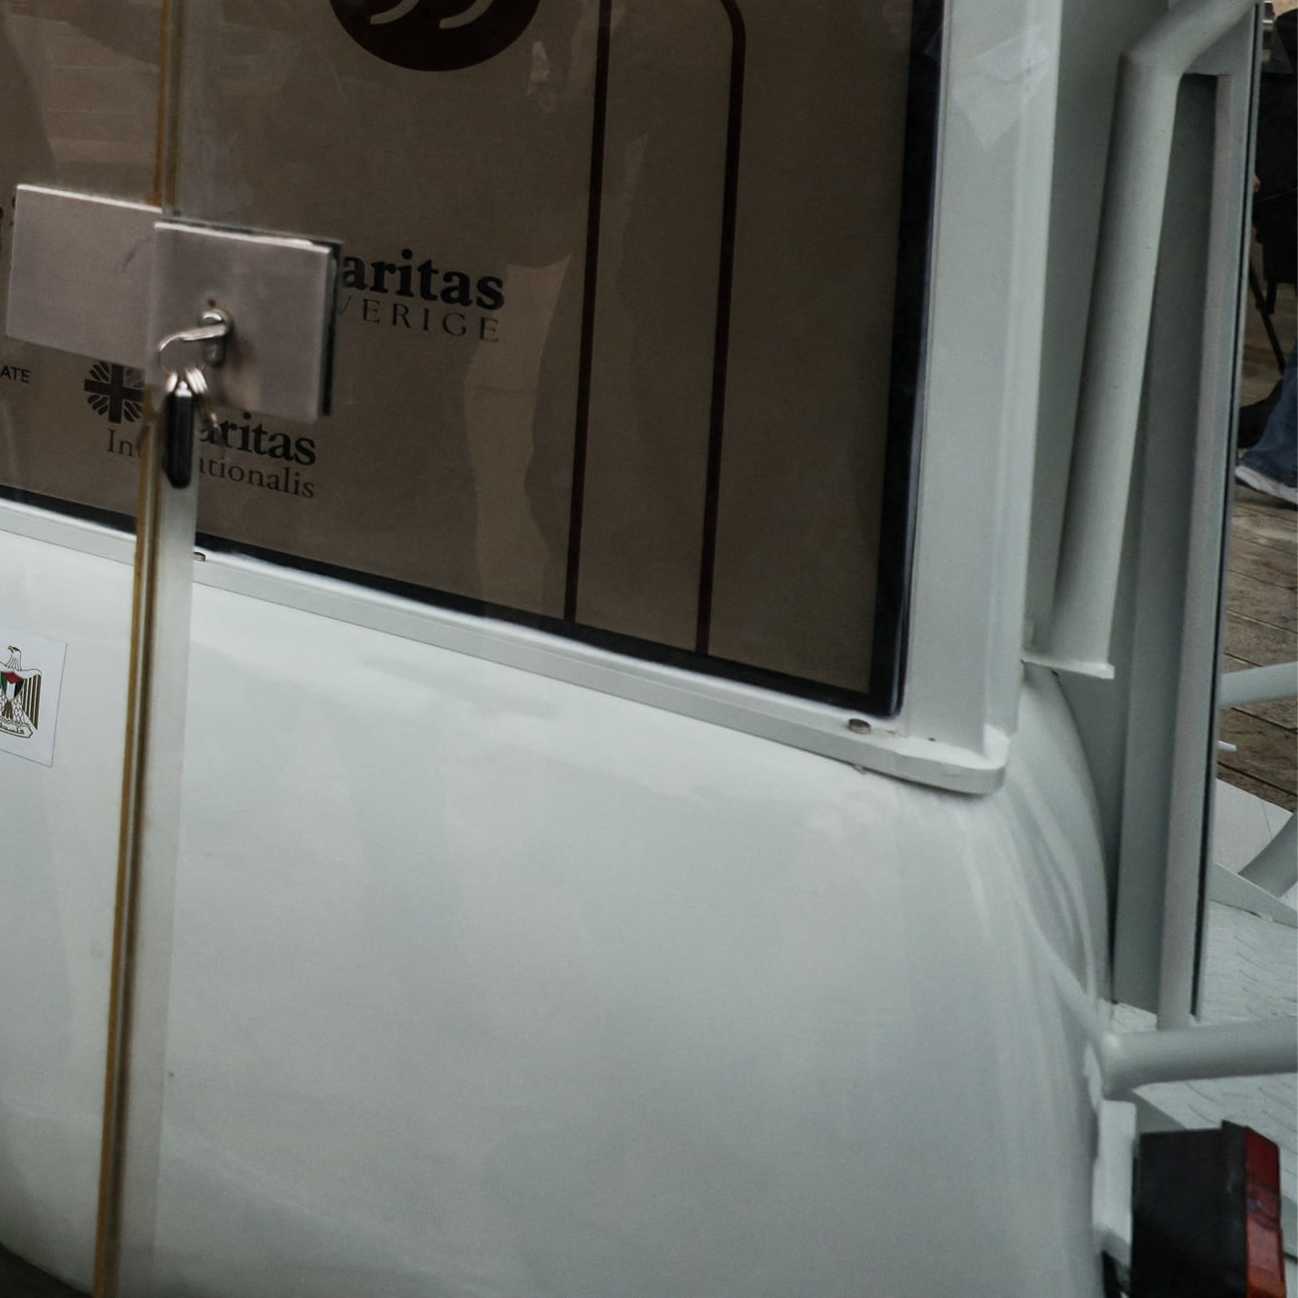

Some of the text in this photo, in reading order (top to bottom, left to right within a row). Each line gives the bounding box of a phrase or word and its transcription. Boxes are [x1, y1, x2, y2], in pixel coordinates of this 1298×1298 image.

[342, 248, 505, 311] aritas
[340, 295, 499, 343] ERIGE
[200, 411, 316, 466] aritas
